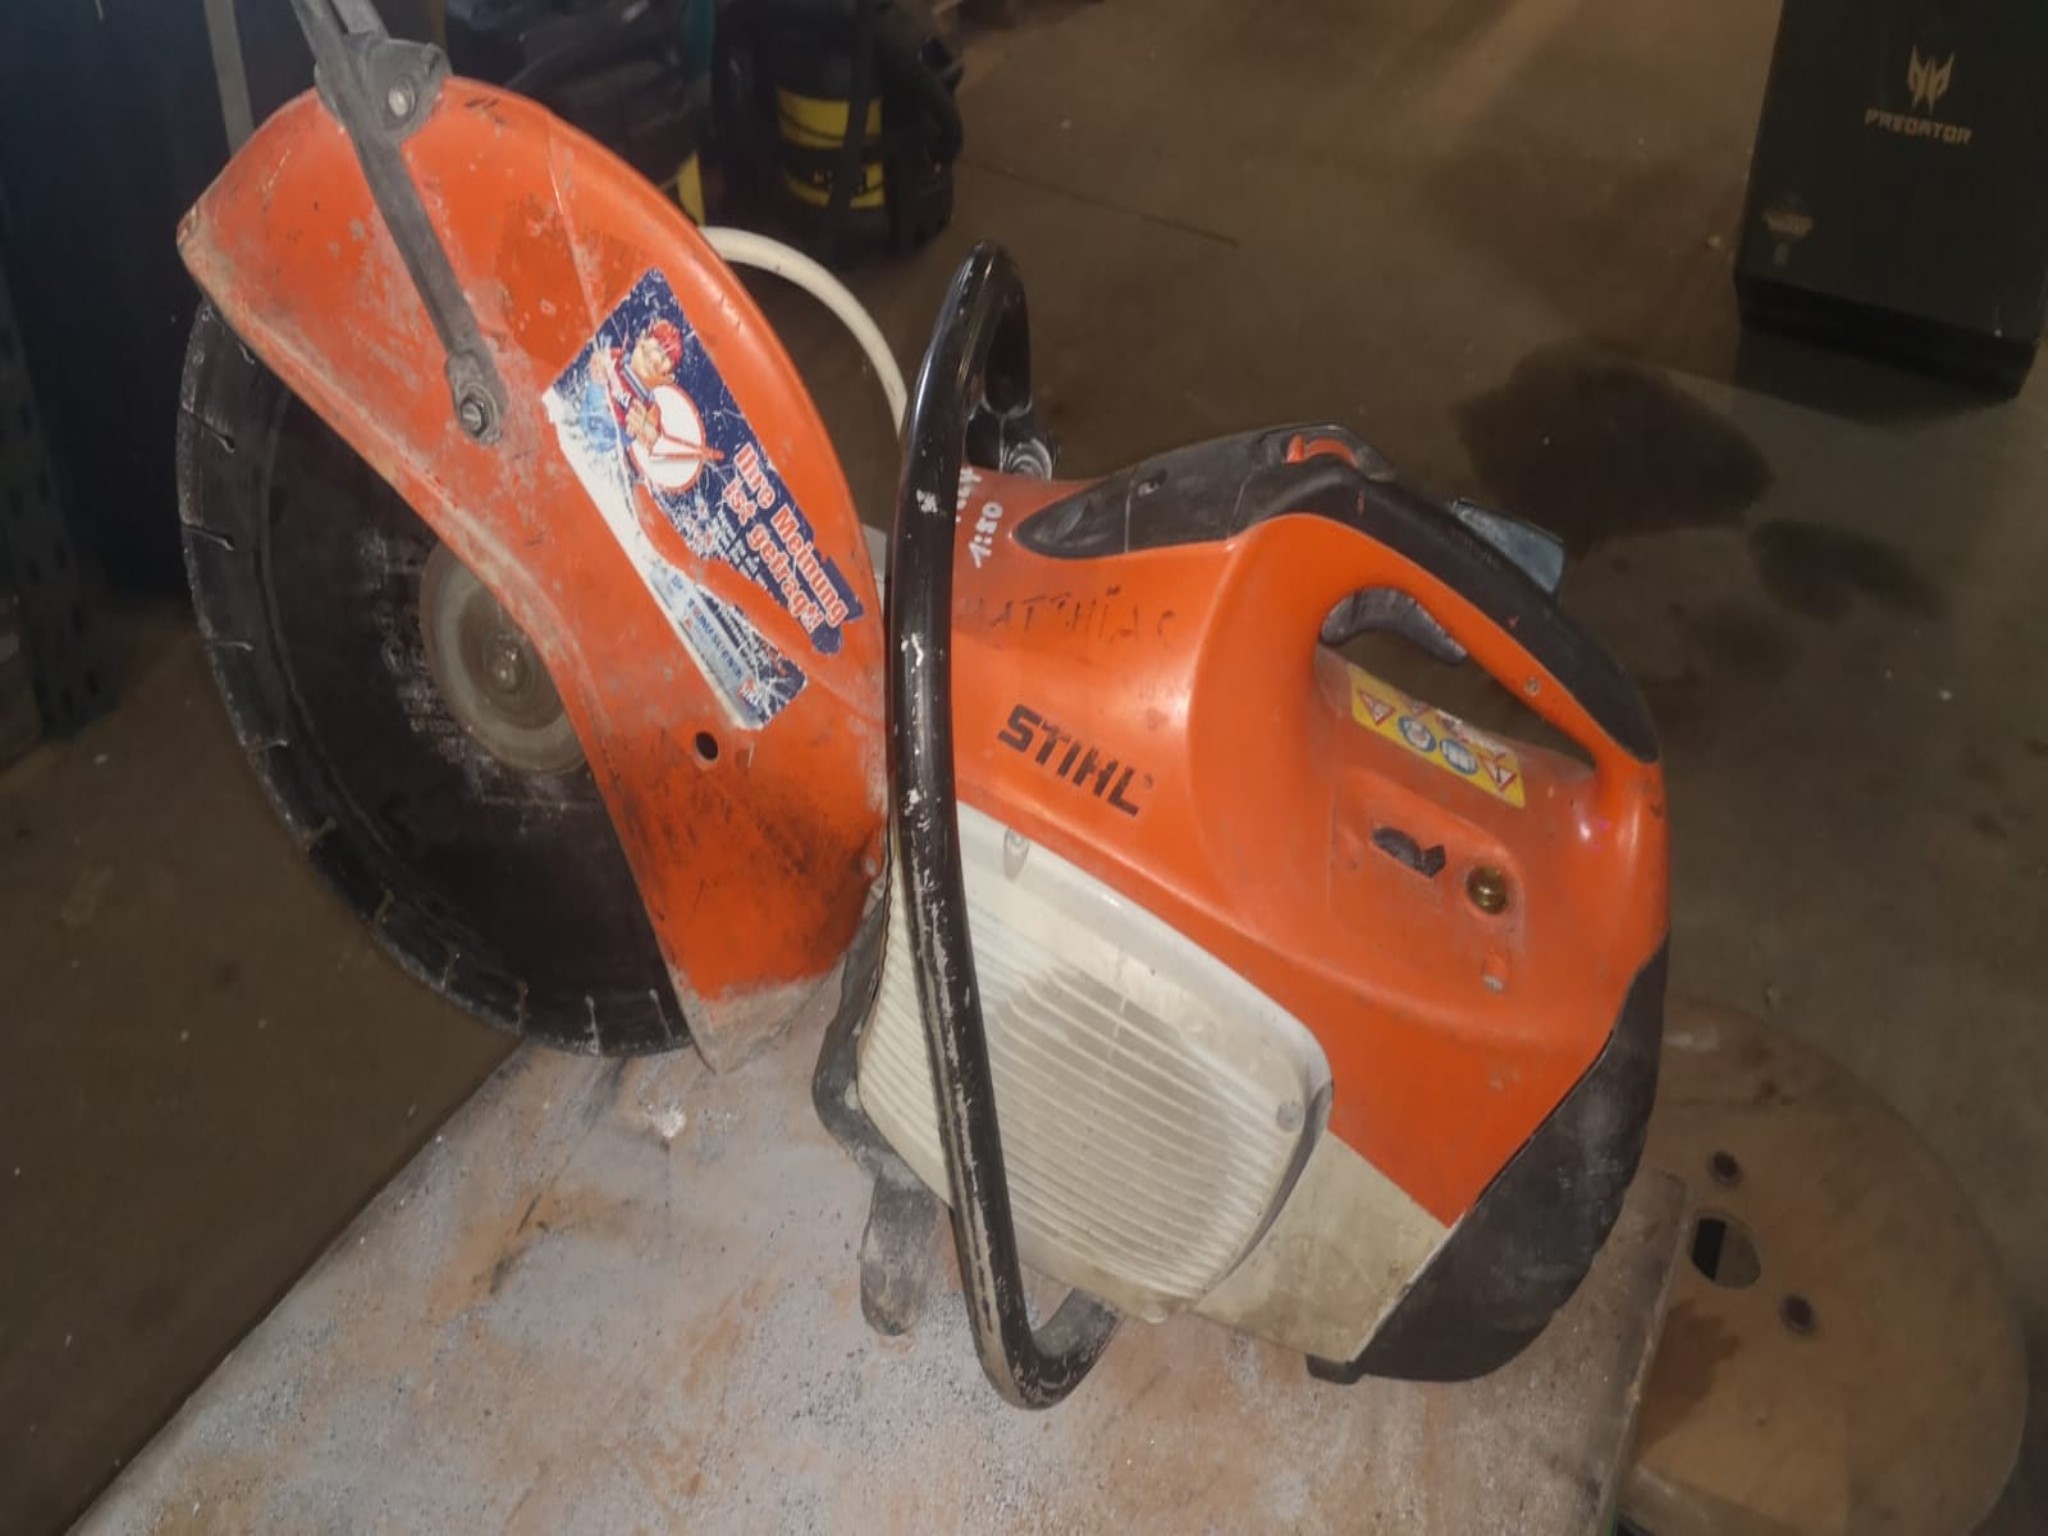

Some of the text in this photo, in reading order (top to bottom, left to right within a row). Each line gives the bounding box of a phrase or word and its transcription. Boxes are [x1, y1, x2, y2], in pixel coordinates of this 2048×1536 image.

[1865, 109, 1973, 144] PREDATOR
[724, 478, 757, 525] ist
[732, 442, 776, 509] Ihre
[771, 503, 848, 628] Meinung
[998, 704, 1142, 817] STIHL
